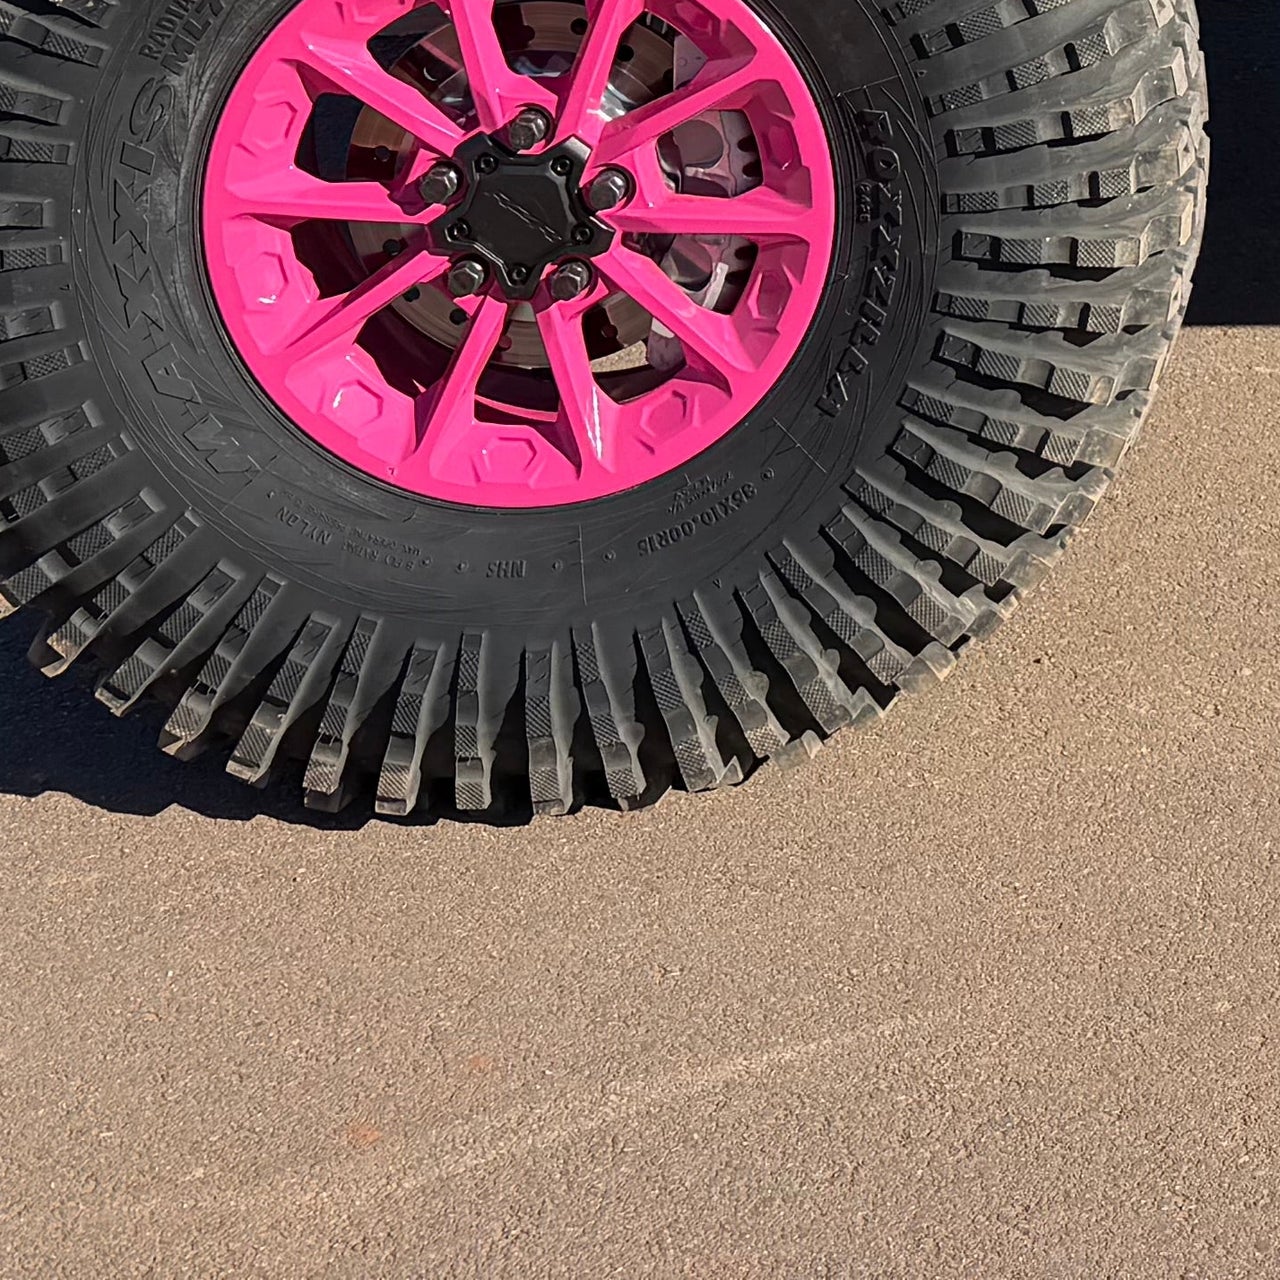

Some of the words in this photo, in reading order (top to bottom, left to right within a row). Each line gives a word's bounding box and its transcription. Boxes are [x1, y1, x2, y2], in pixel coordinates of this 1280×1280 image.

[111, 74, 259, 474] MAXXIS
[822, 110, 902, 418] ROXXZILLA
[278, 506, 334, 545] NYLON
[485, 559, 524, 578] NHS
